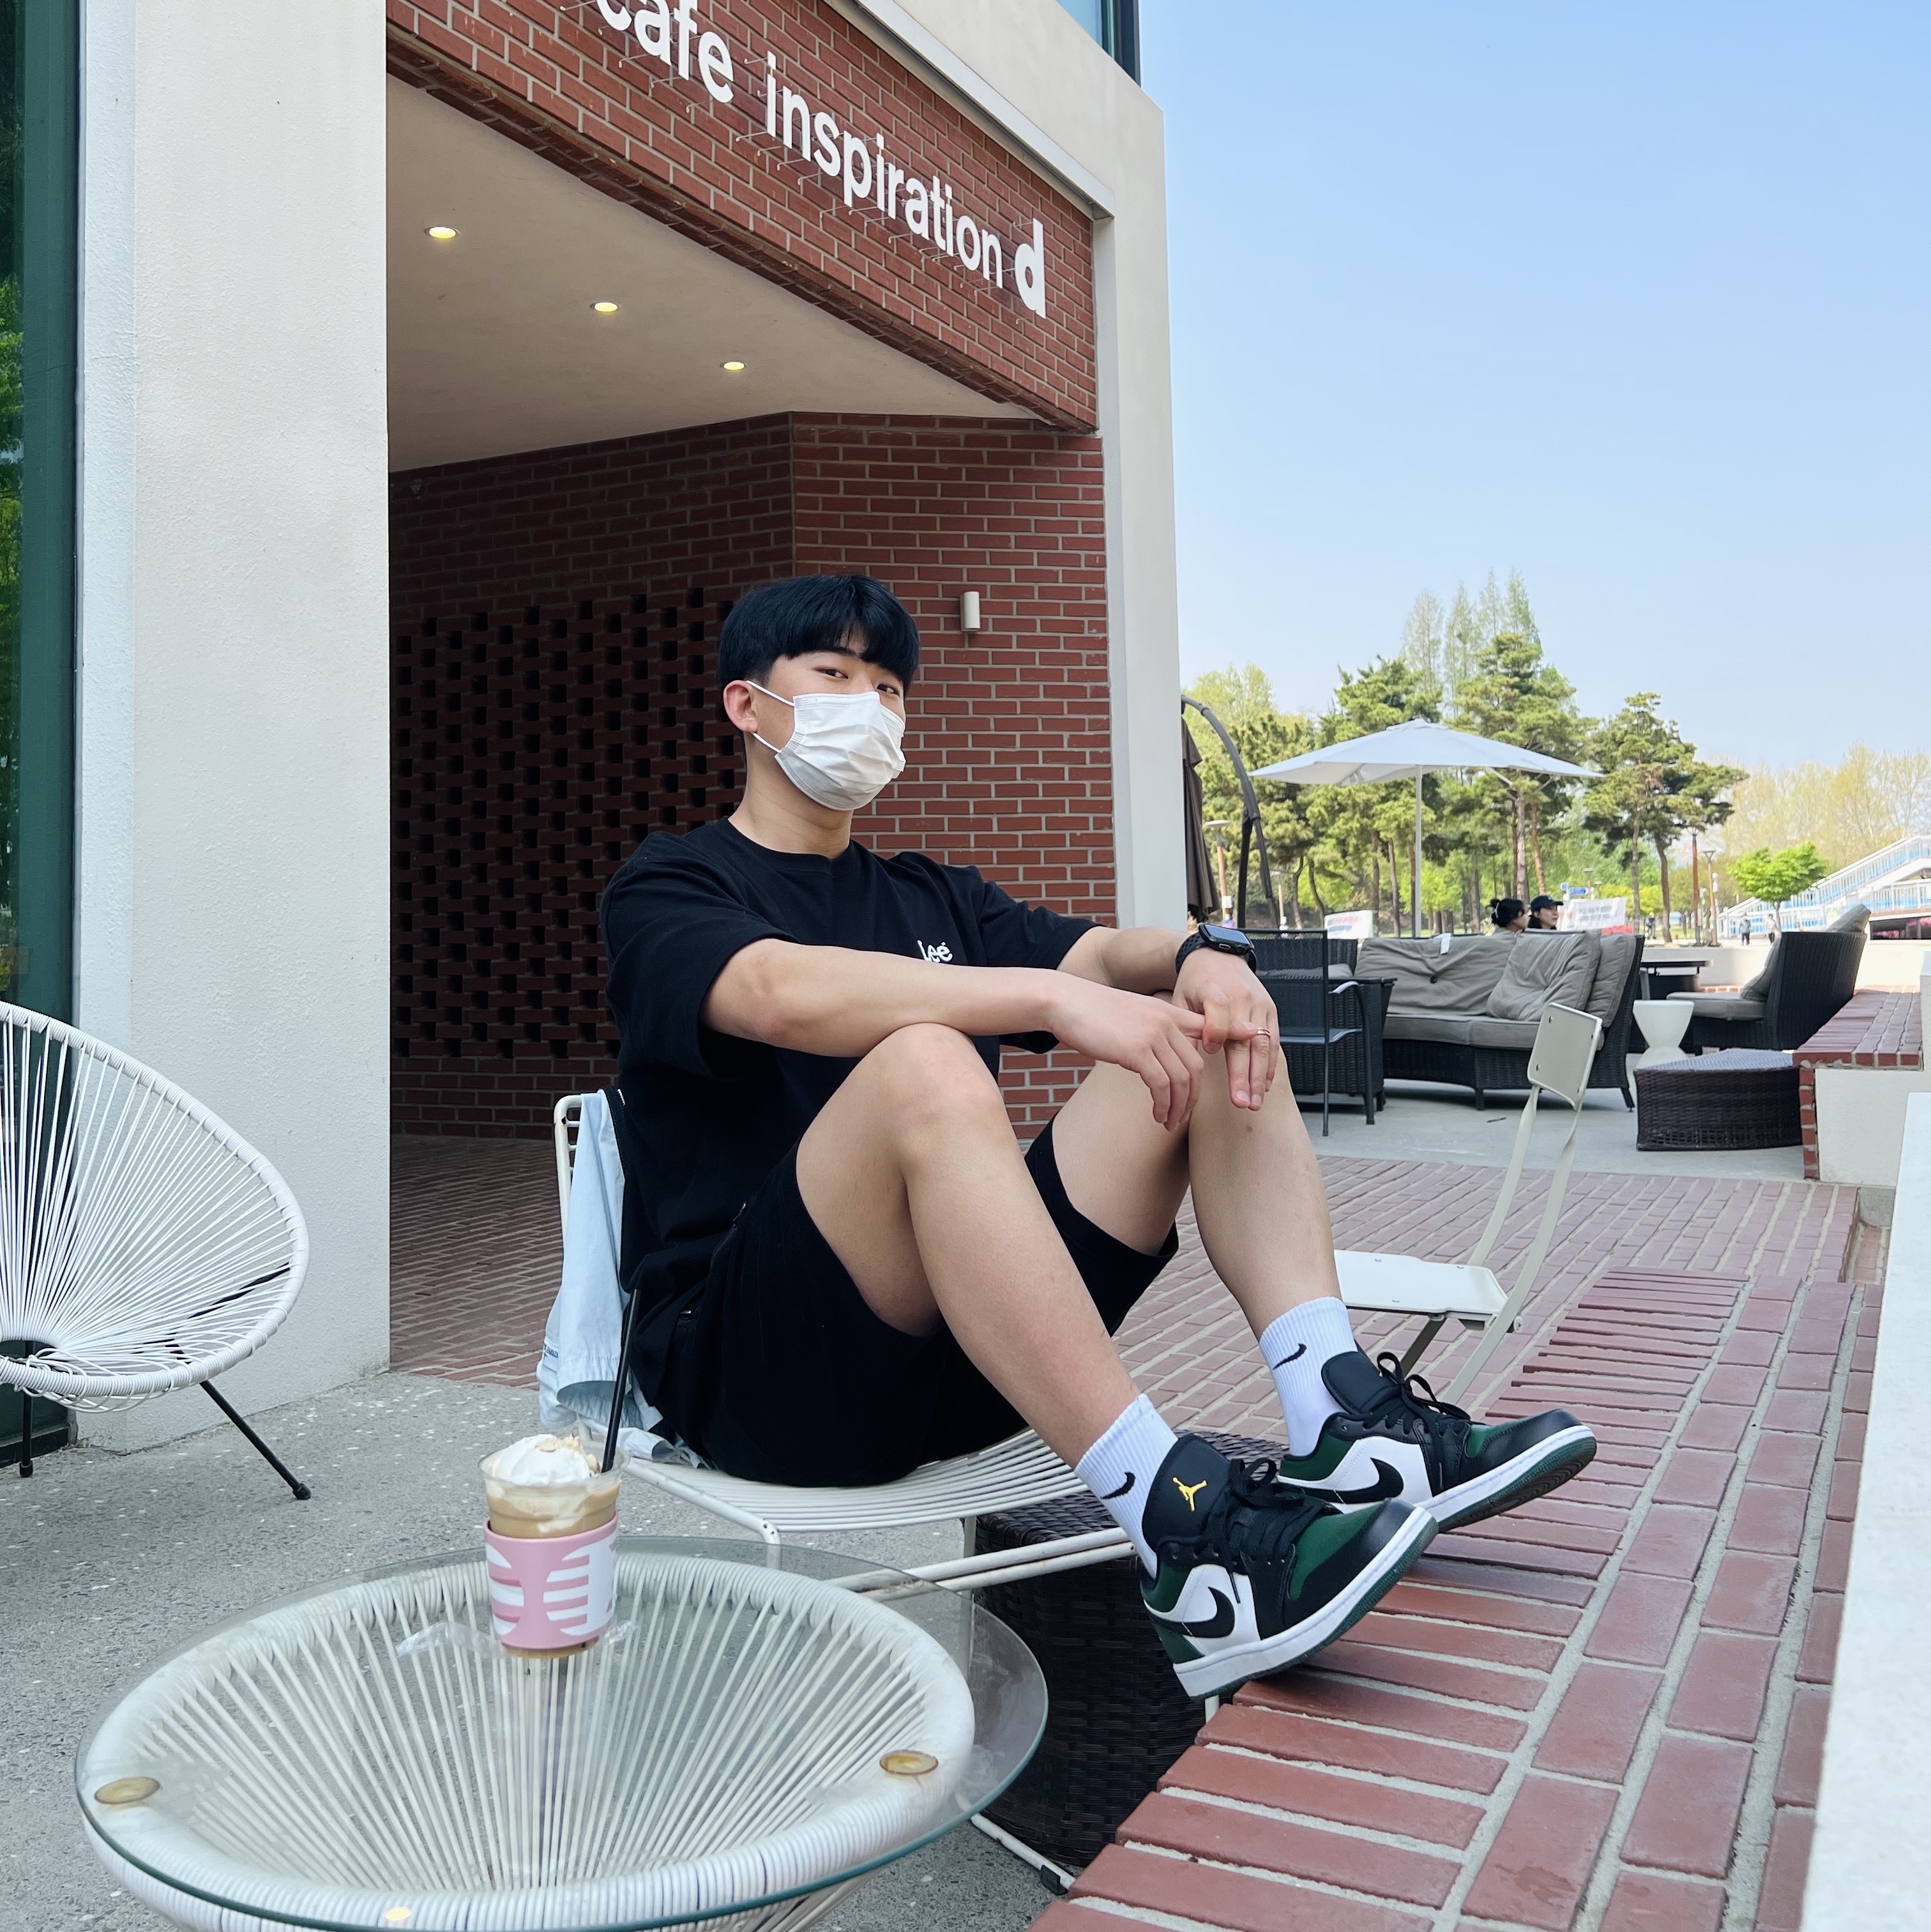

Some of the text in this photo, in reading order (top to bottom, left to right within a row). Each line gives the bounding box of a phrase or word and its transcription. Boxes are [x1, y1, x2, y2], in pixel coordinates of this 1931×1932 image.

[767, 51, 1003, 289] inspiration
[1015, 218, 1046, 319] d
[917, 939, 953, 962] Lee
